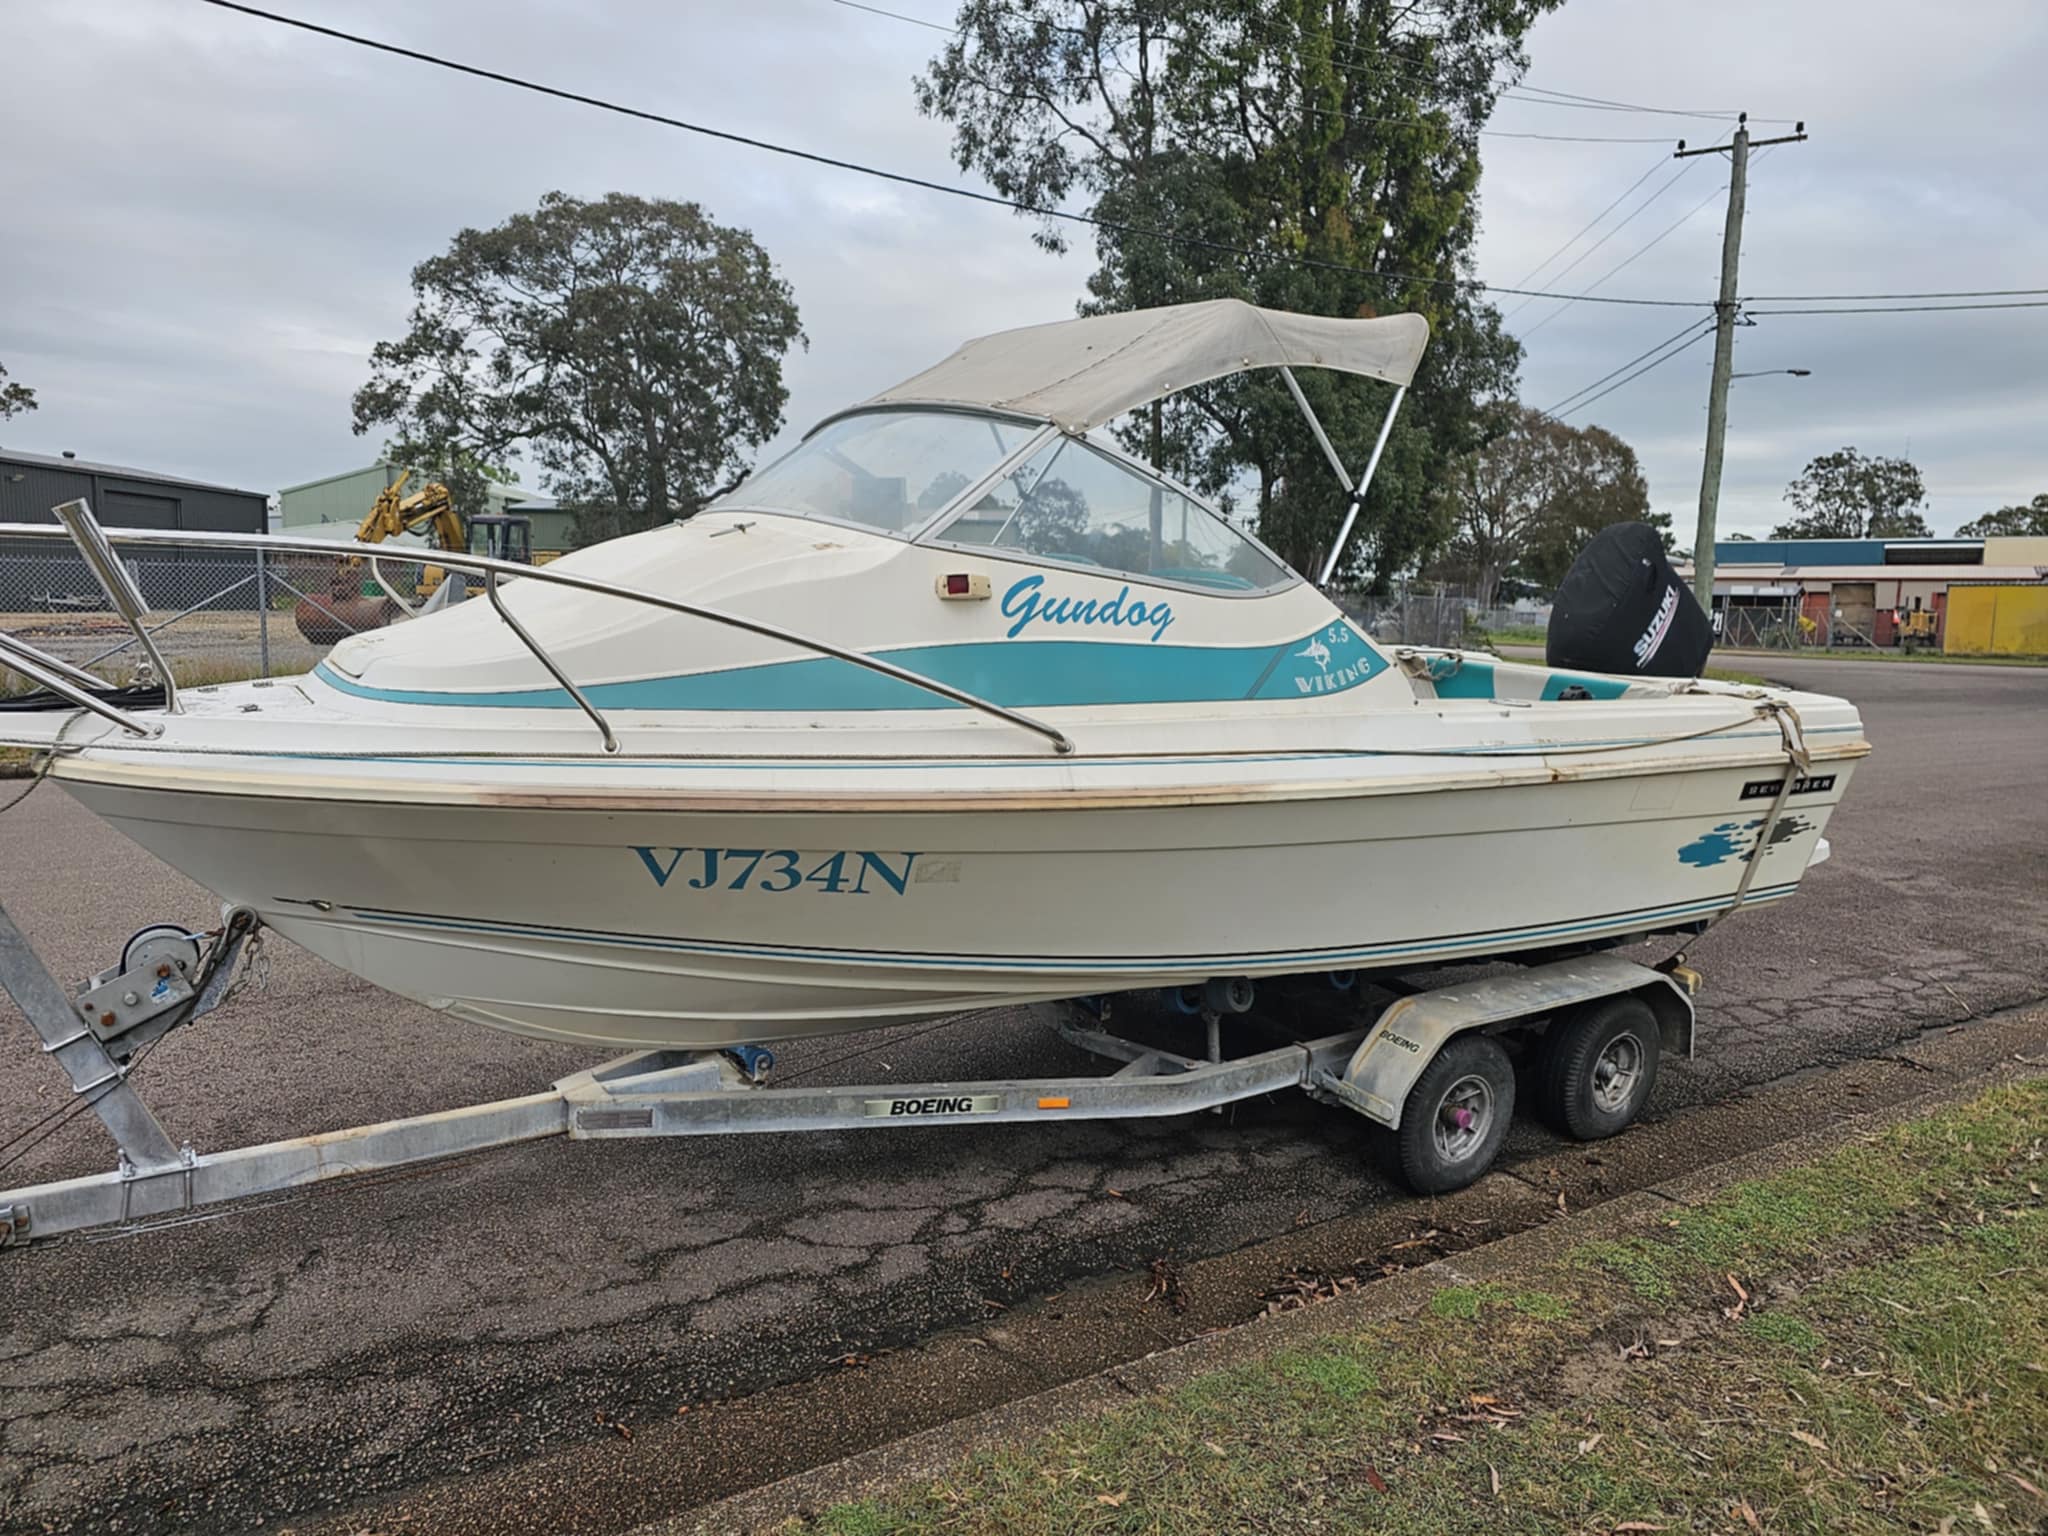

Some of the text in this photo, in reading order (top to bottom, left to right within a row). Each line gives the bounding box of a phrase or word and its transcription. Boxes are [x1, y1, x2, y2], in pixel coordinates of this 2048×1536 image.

[1001, 574, 1176, 642] Gundog
[1633, 584, 1676, 657] SUZUKI
[1328, 627, 1349, 643] 5.5
[1294, 657, 1370, 693] VIKING
[627, 846, 924, 896] VJ734N
[1379, 1029, 1420, 1053] BOEING
[890, 1097, 973, 1116] BOEING
